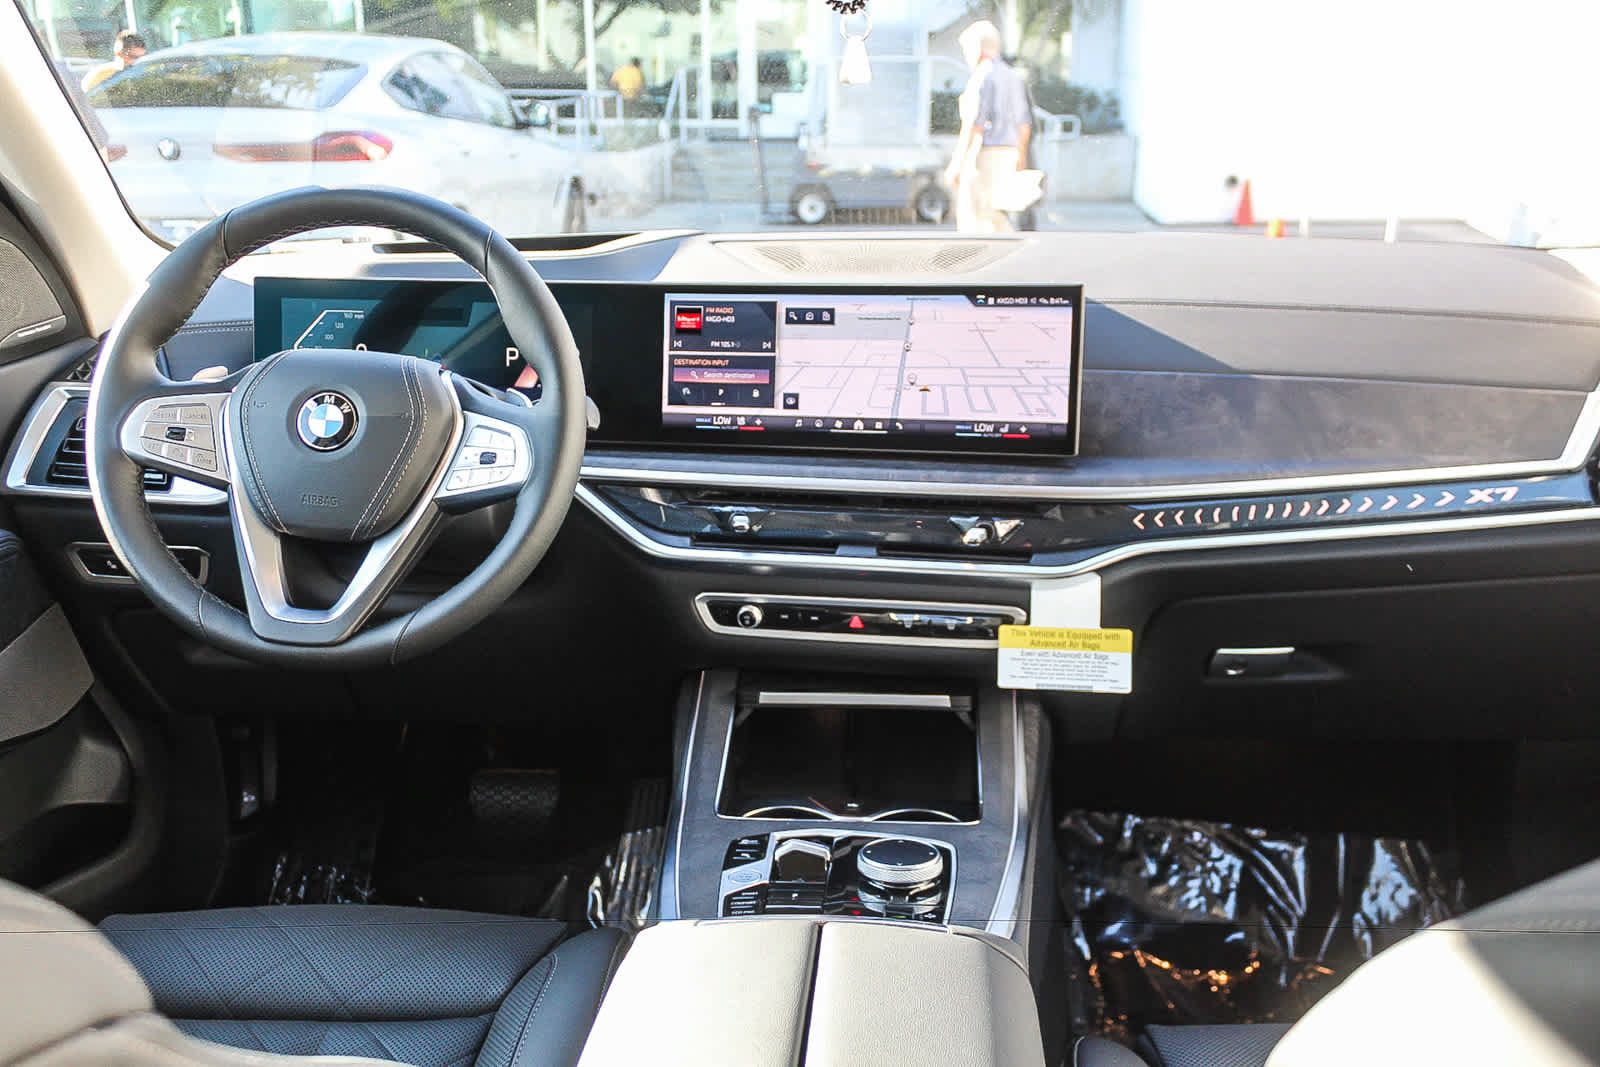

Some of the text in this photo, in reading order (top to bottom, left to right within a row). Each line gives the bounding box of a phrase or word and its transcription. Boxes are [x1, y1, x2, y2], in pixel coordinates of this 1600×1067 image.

[506, 348, 519, 366] P
[674, 358, 730, 367] DESTINATION INPUT
[703, 370, 723, 378] Search
[304, 395, 352, 416] BMW
[712, 416, 732, 425] LOW
[974, 423, 994, 433] LOW
[301, 493, 338, 506] AIRBAG
[1464, 486, 1520, 505] X7
[1011, 629, 1121, 642] This Vehicle is Equipped with
[1029, 639, 1101, 650] Advanced Air Bags
[1051, 651, 1082, 659] Advanced
[1083, 652, 1093, 660] Air
